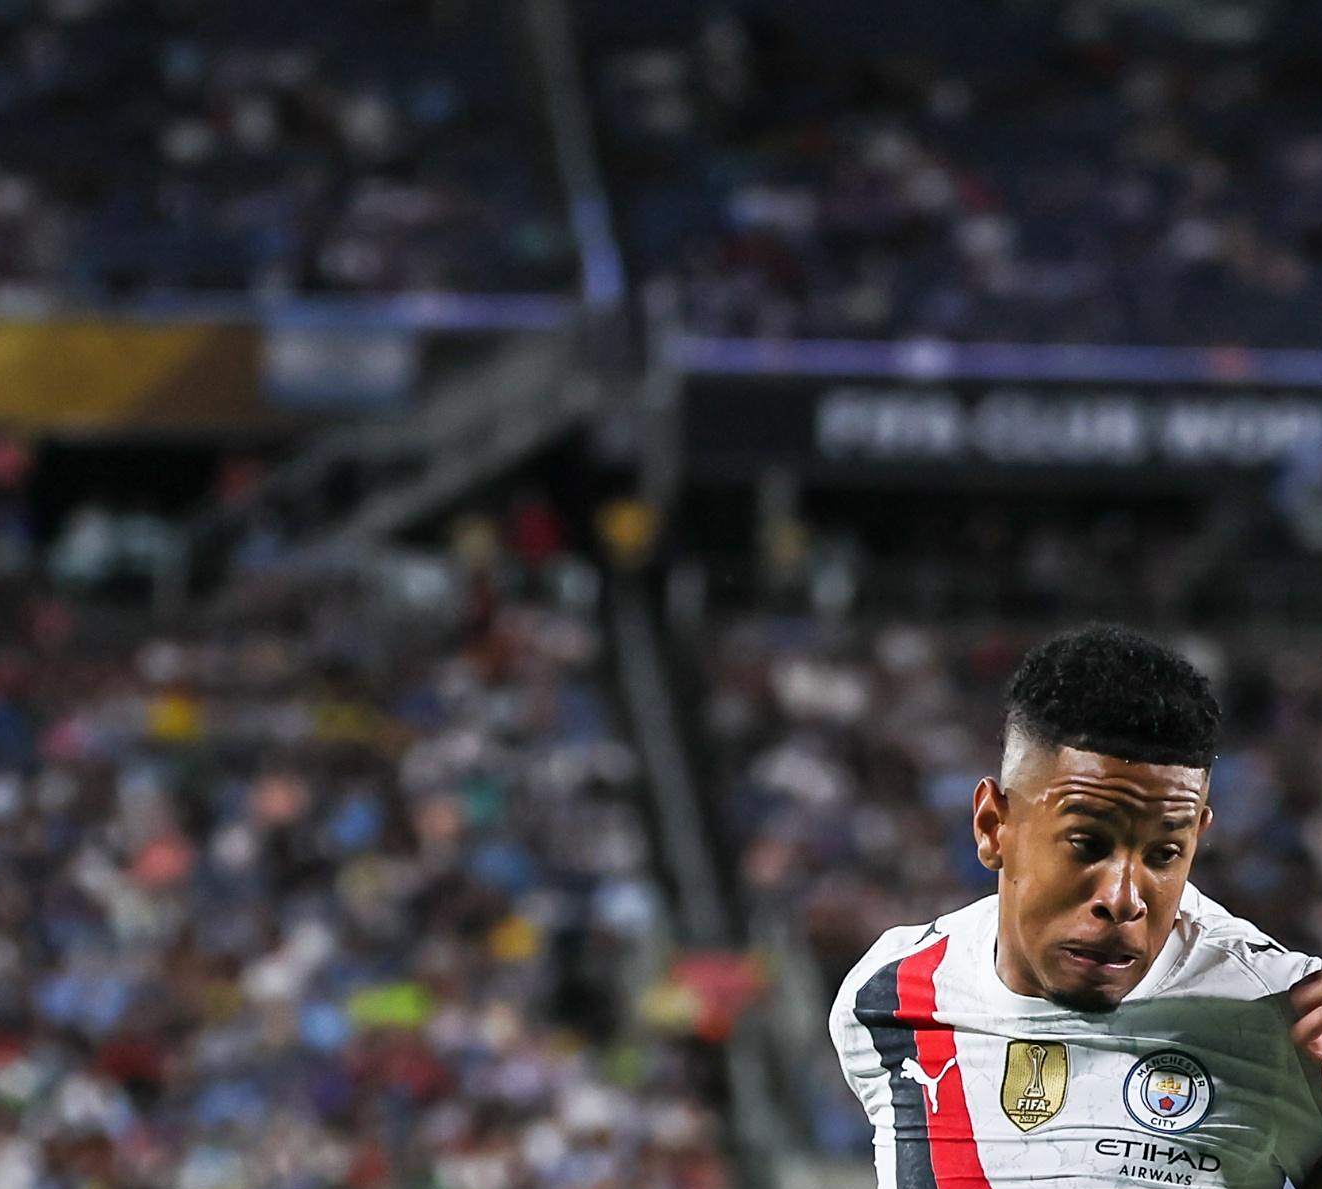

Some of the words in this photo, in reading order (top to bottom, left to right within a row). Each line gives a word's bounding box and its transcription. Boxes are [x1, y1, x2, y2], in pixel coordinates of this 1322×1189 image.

[1136, 1055, 1206, 1089] MANCHESTER
[1017, 1098, 1046, 1111] FIFA
[1150, 1117, 1176, 1129] CITY
[1095, 1139, 1221, 1172] ETIHAD
[1119, 1164, 1192, 1186] AIRWAYS
